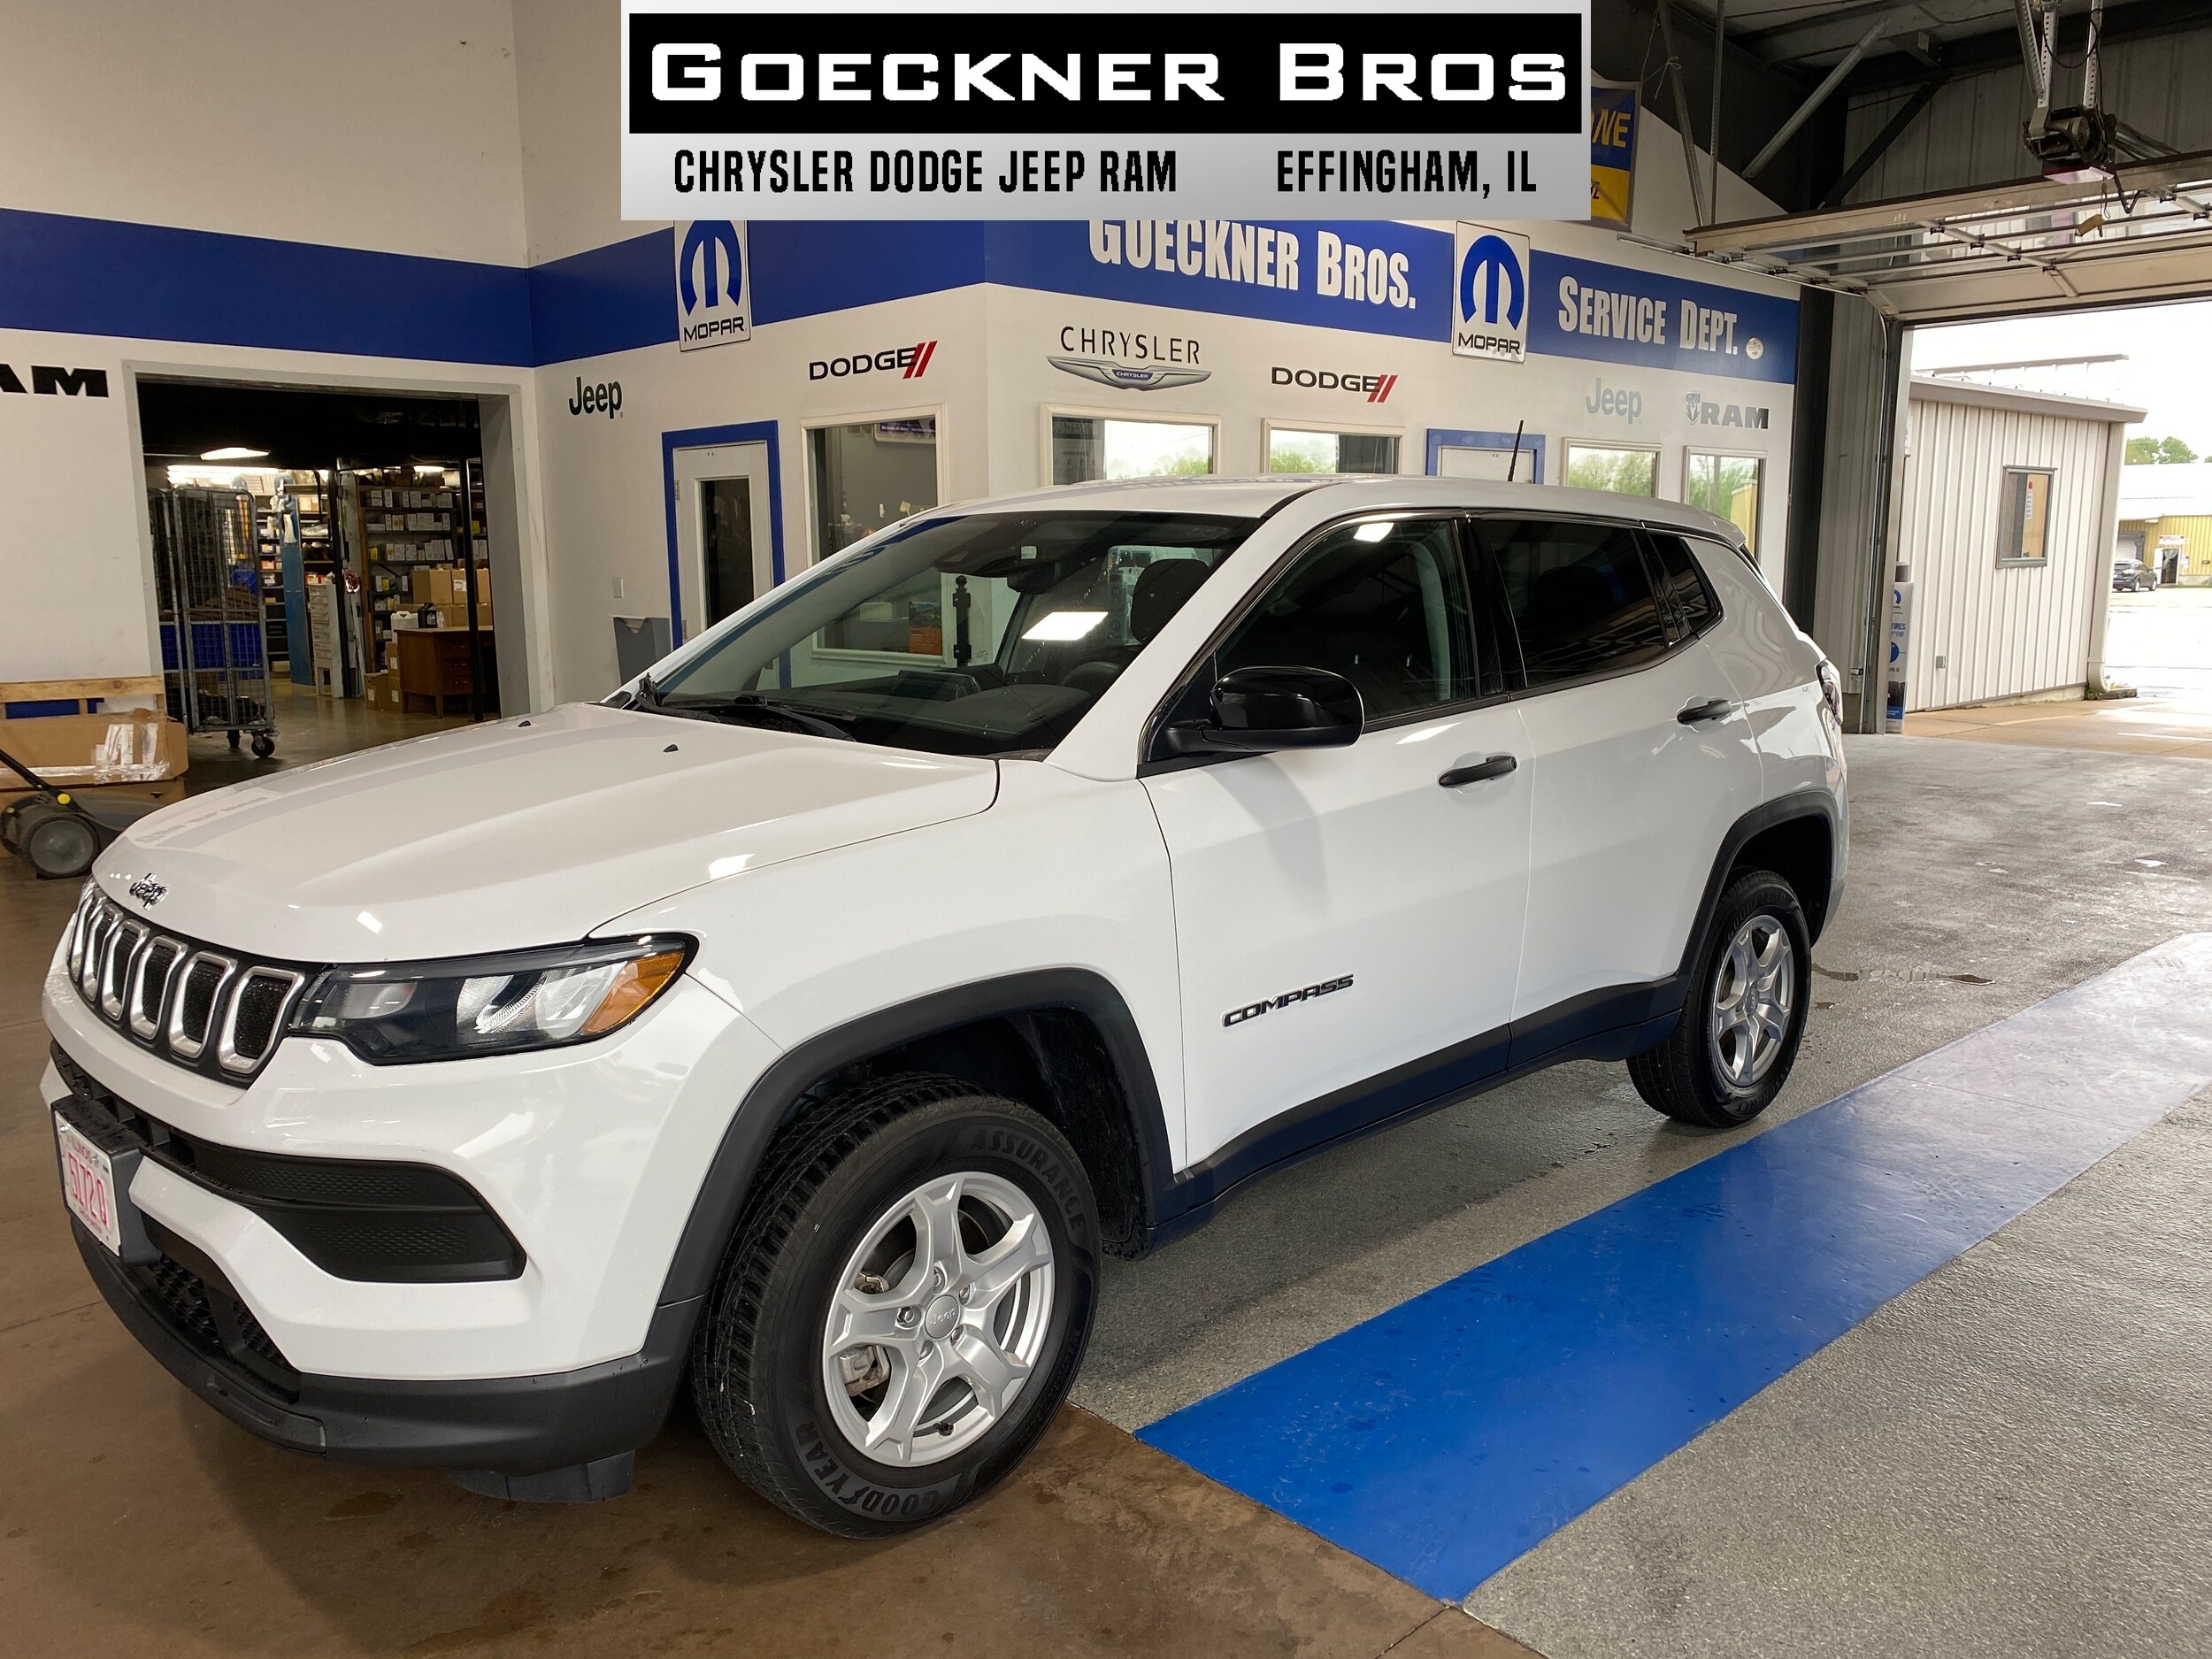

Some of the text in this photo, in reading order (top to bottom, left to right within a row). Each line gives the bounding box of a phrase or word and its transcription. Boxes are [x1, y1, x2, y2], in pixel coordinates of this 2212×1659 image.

[1591, 108, 1631, 148] NE
[1088, 219, 1417, 309] GOECKNER BROS.
[683, 316, 746, 342] MOPAR
[1558, 275, 1739, 355] SERVICE DEPT.
[810, 347, 918, 380] DODGE
[1061, 326, 1200, 365] CHRYSLER
[1458, 332, 1521, 355] MOPAR
[568, 376, 622, 419] Jeep
[1271, 366, 1380, 393] DODGE
[1585, 377, 1643, 425] Jeep
[1701, 401, 1769, 430] RAM
[1221, 972, 1354, 1028] COMPASS
[969, 1129, 1086, 1231] ASSURANCE
[929, 1308, 956, 1326] Jeep
[795, 1418, 941, 1516] GOODYEAR
